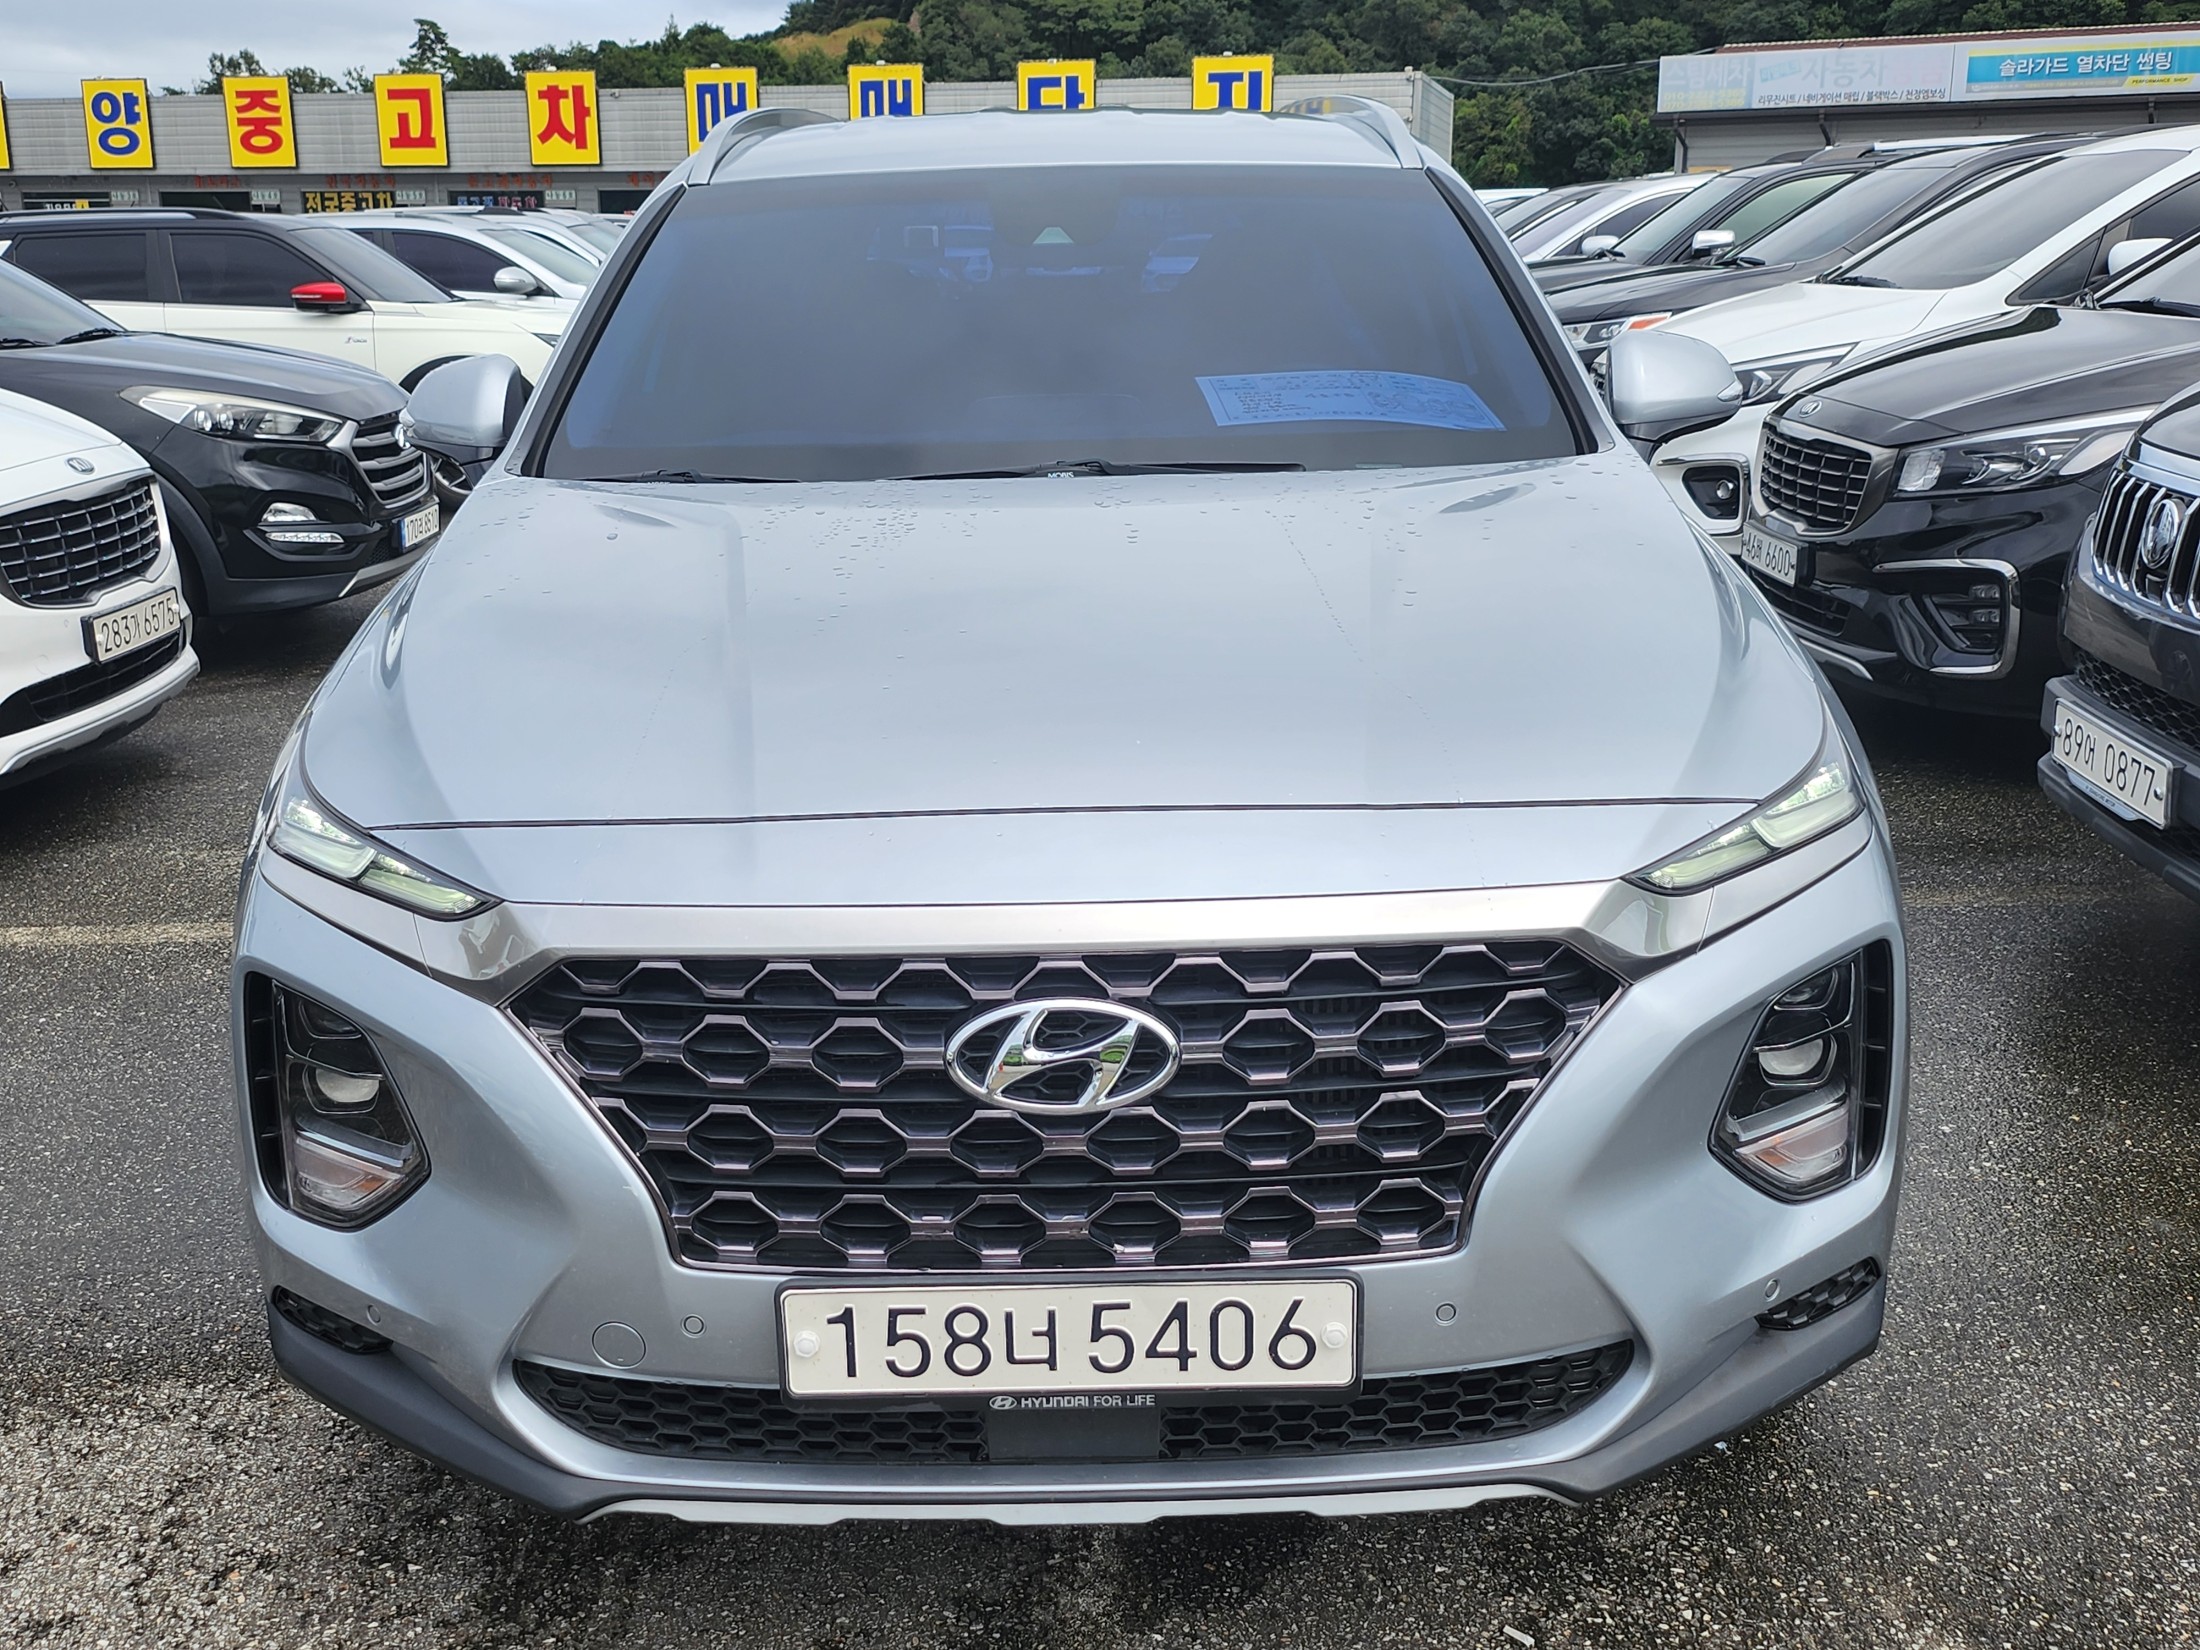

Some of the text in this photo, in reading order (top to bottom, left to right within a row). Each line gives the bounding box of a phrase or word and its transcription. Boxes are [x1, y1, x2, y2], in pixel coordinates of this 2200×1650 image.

[1664, 58, 1751, 89] 스팀세차
[1802, 52, 1888, 88] 자동차
[1999, 51, 2173, 77] 솔라가드 열차단 썬팅
[2131, 77, 2170, 85] PERFORMANCE
[1758, 94, 1796, 106] 리무진시트
[1802, 92, 1842, 104] 네비게이션
[1843, 91, 1860, 102] 매립
[1866, 90, 1899, 102] 블랙박스
[91, 91, 142, 156] 양
[234, 89, 283, 154] 중
[386, 88, 437, 149] 고
[537, 84, 592, 150] 차
[1765, 541, 1791, 577] 6600
[101, 597, 175, 653] 283가 6575
[2062, 718, 2156, 806] 89어 0877
[826, 1297, 1318, 1378] 158너 5406
[1021, 1394, 1156, 1408] HYUNDAI FOR LIFE
